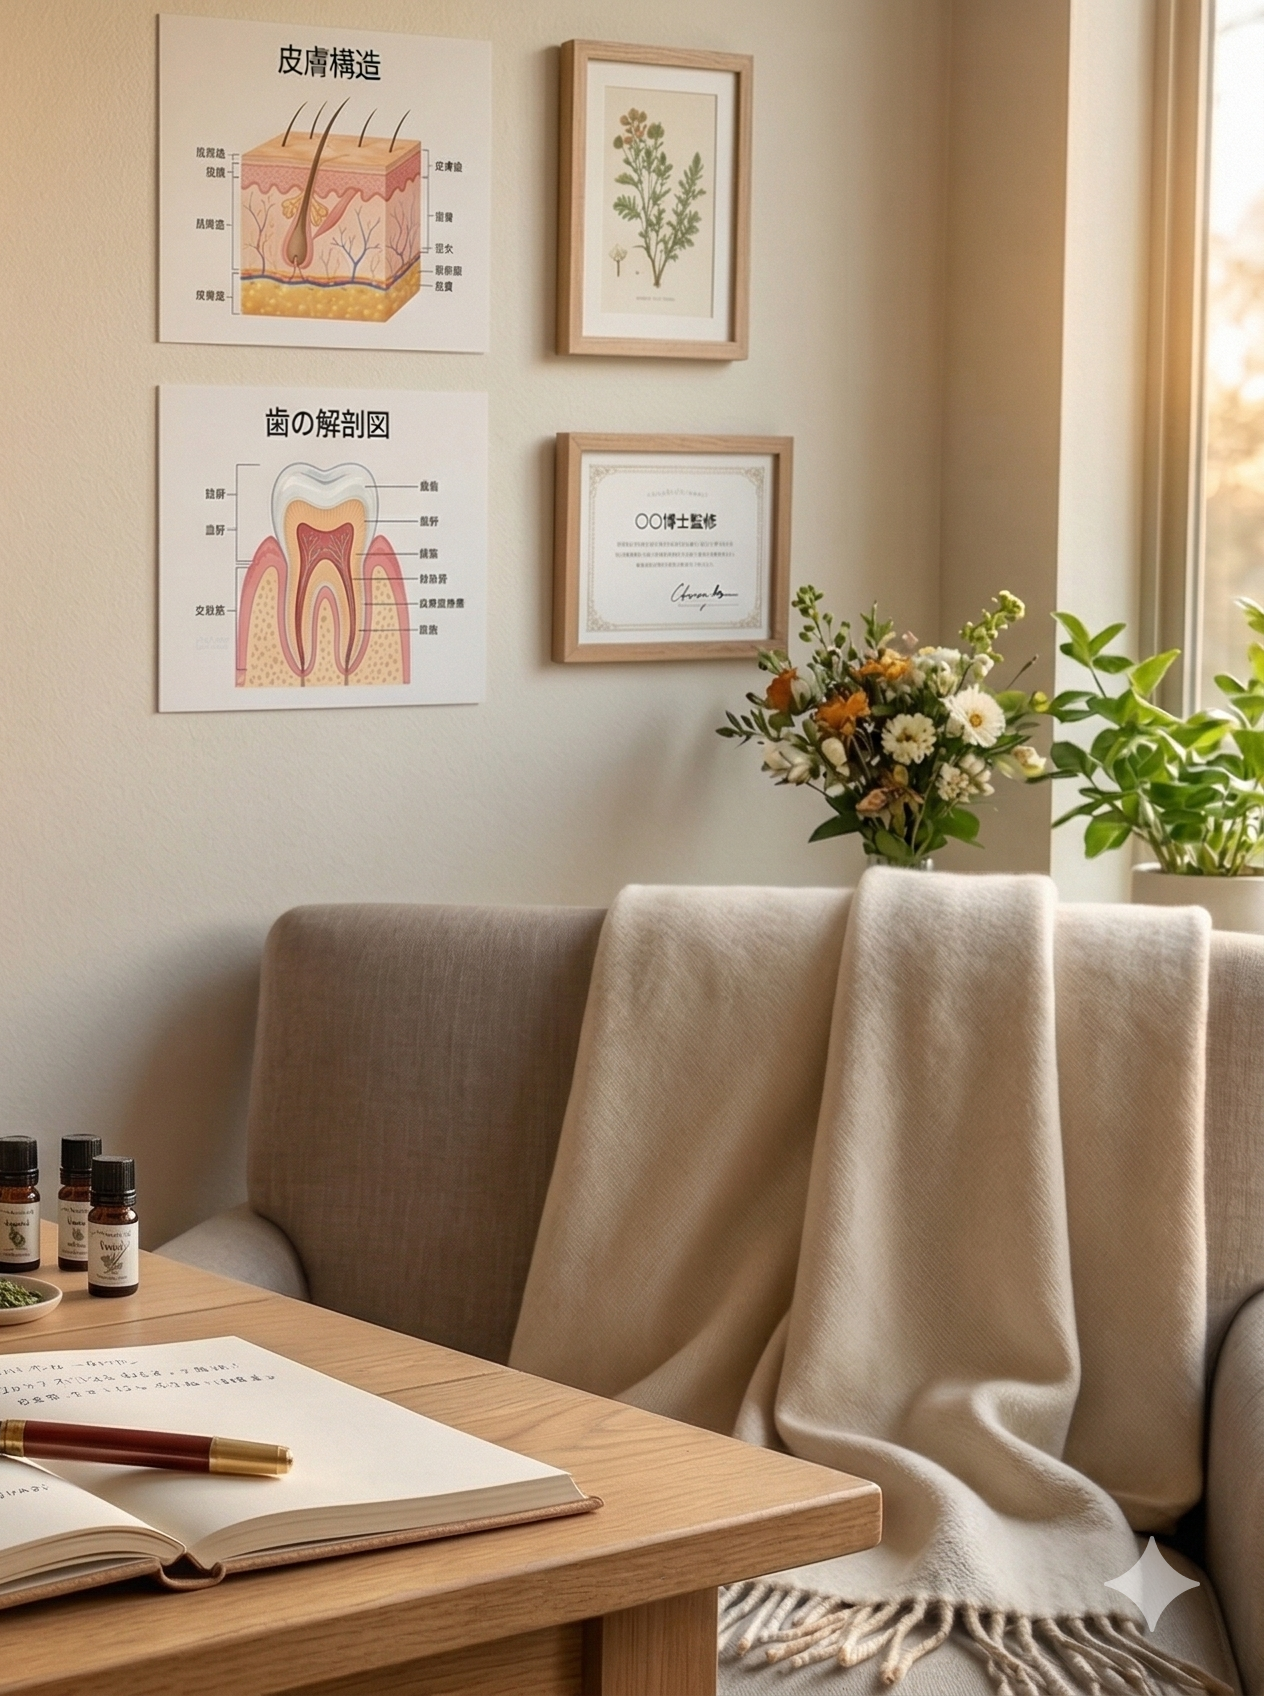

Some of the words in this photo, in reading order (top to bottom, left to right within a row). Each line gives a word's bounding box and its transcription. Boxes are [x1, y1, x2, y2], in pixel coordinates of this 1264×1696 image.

[277, 44, 382, 81] 皮膚構造
[265, 406, 390, 439] 歯の解剖図
